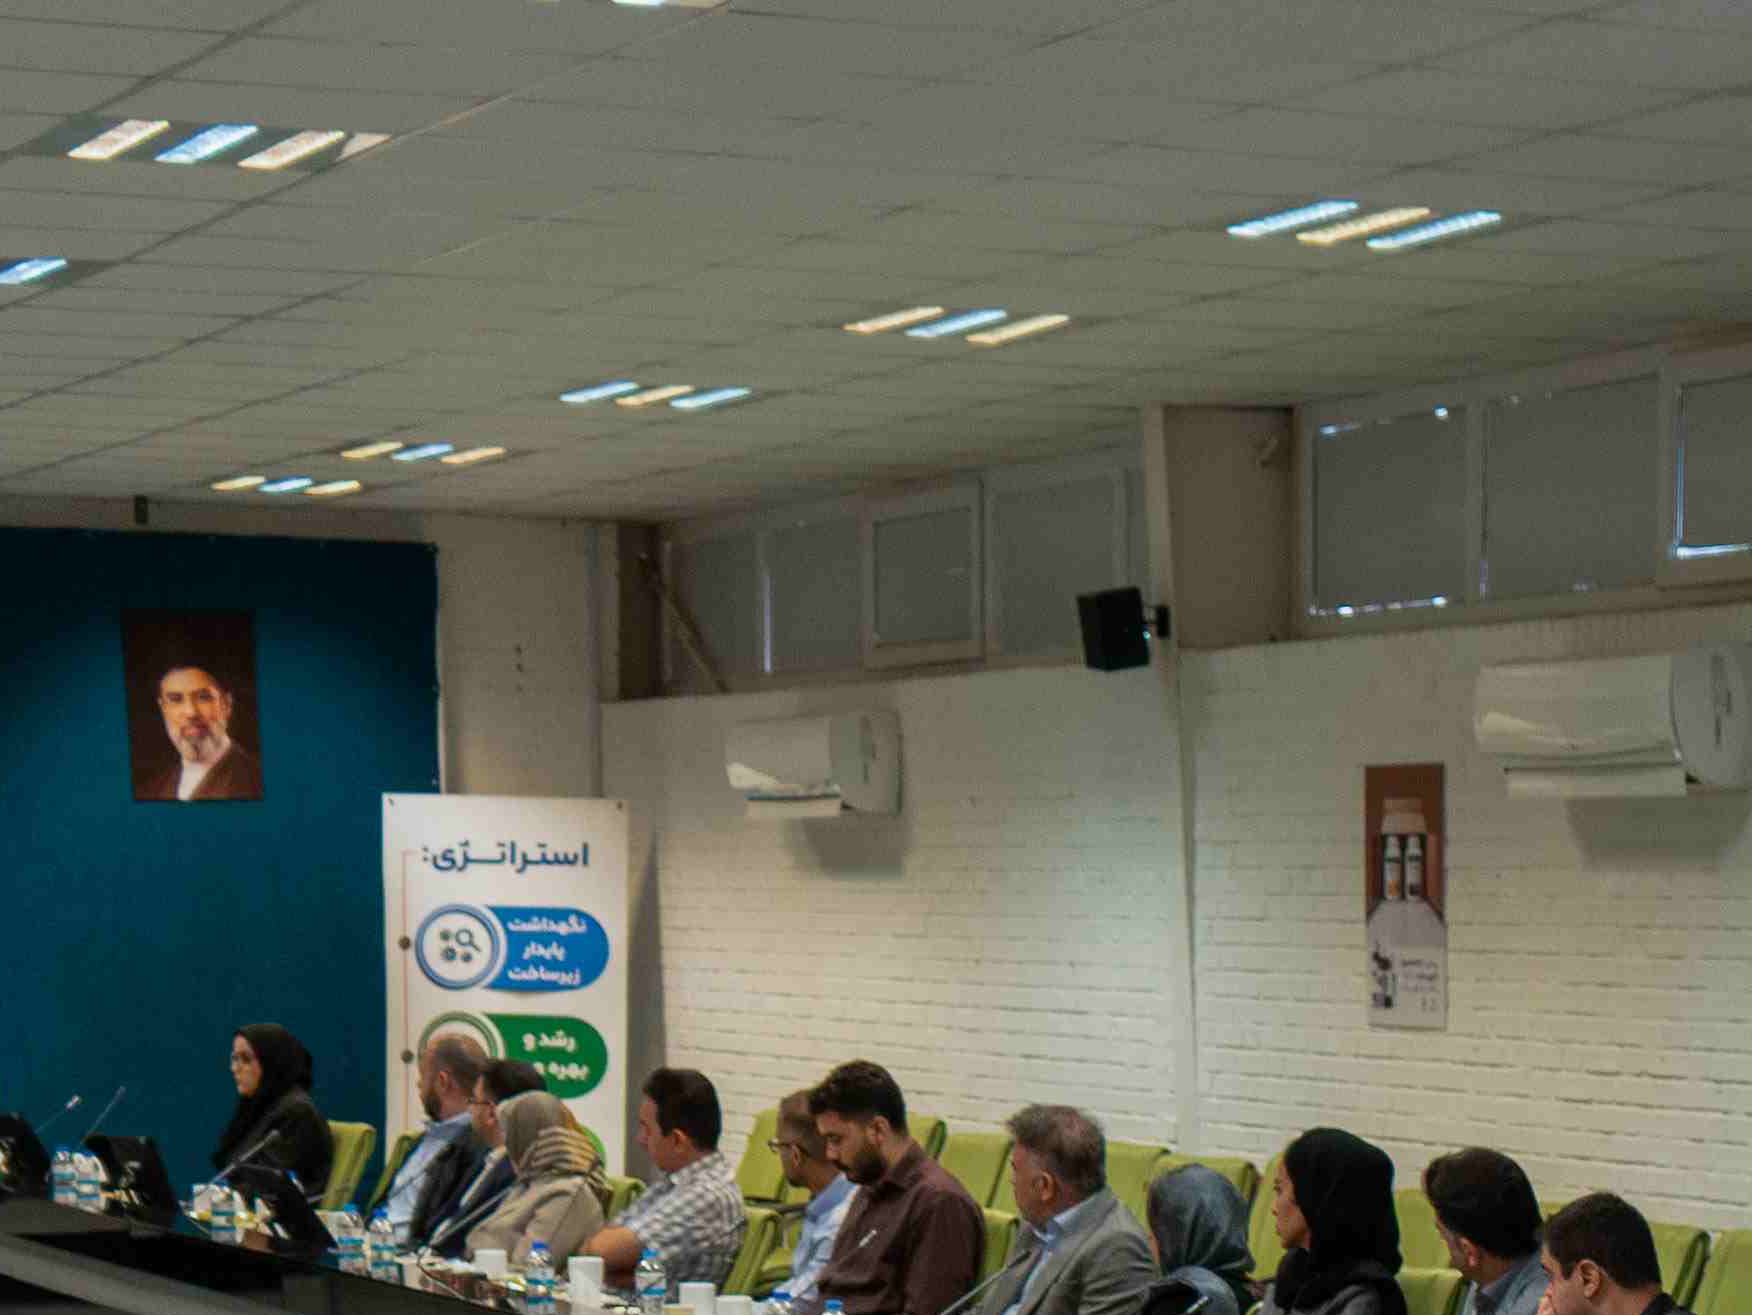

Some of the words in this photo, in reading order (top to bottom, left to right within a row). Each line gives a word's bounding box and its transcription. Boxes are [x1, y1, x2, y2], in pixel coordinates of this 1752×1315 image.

[507, 914, 588, 936] نگهداشت
[507, 965, 581, 986] زیرساخت
[522, 1033, 537, 1052] و
[539, 1030, 576, 1053] رشد
